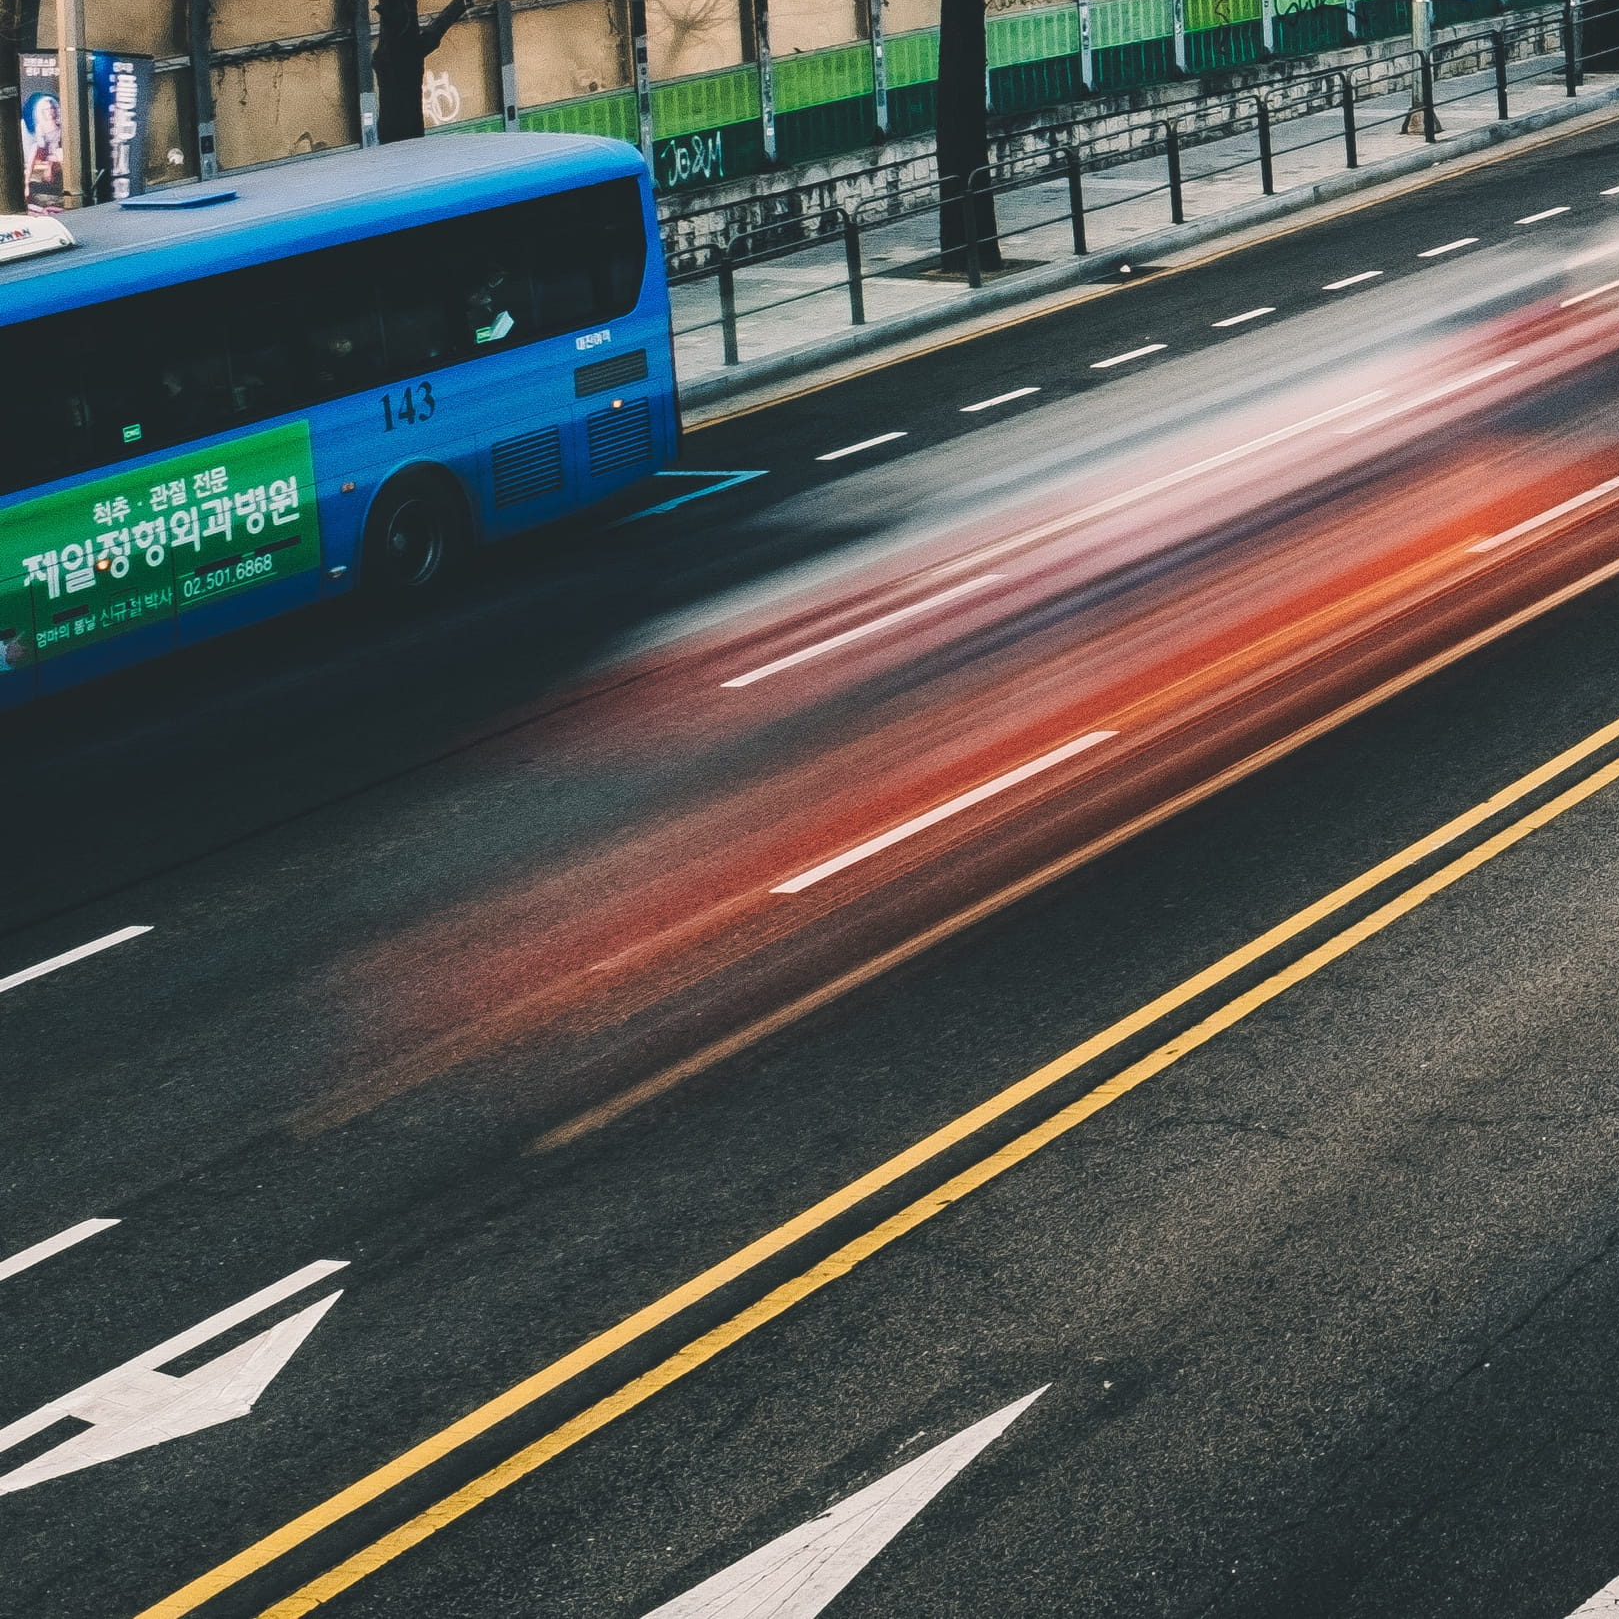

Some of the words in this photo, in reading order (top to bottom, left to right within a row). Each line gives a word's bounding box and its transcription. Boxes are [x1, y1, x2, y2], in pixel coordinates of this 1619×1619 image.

[380, 381, 435, 433] 143
[93, 496, 131, 527] 척추
[149, 479, 187, 512] 관절
[193, 466, 229, 498] 전문
[22, 475, 301, 599] 제일정형외과병원
[183, 553, 273, 598] 02.501.6868
[36, 622, 70, 649] 엄마의
